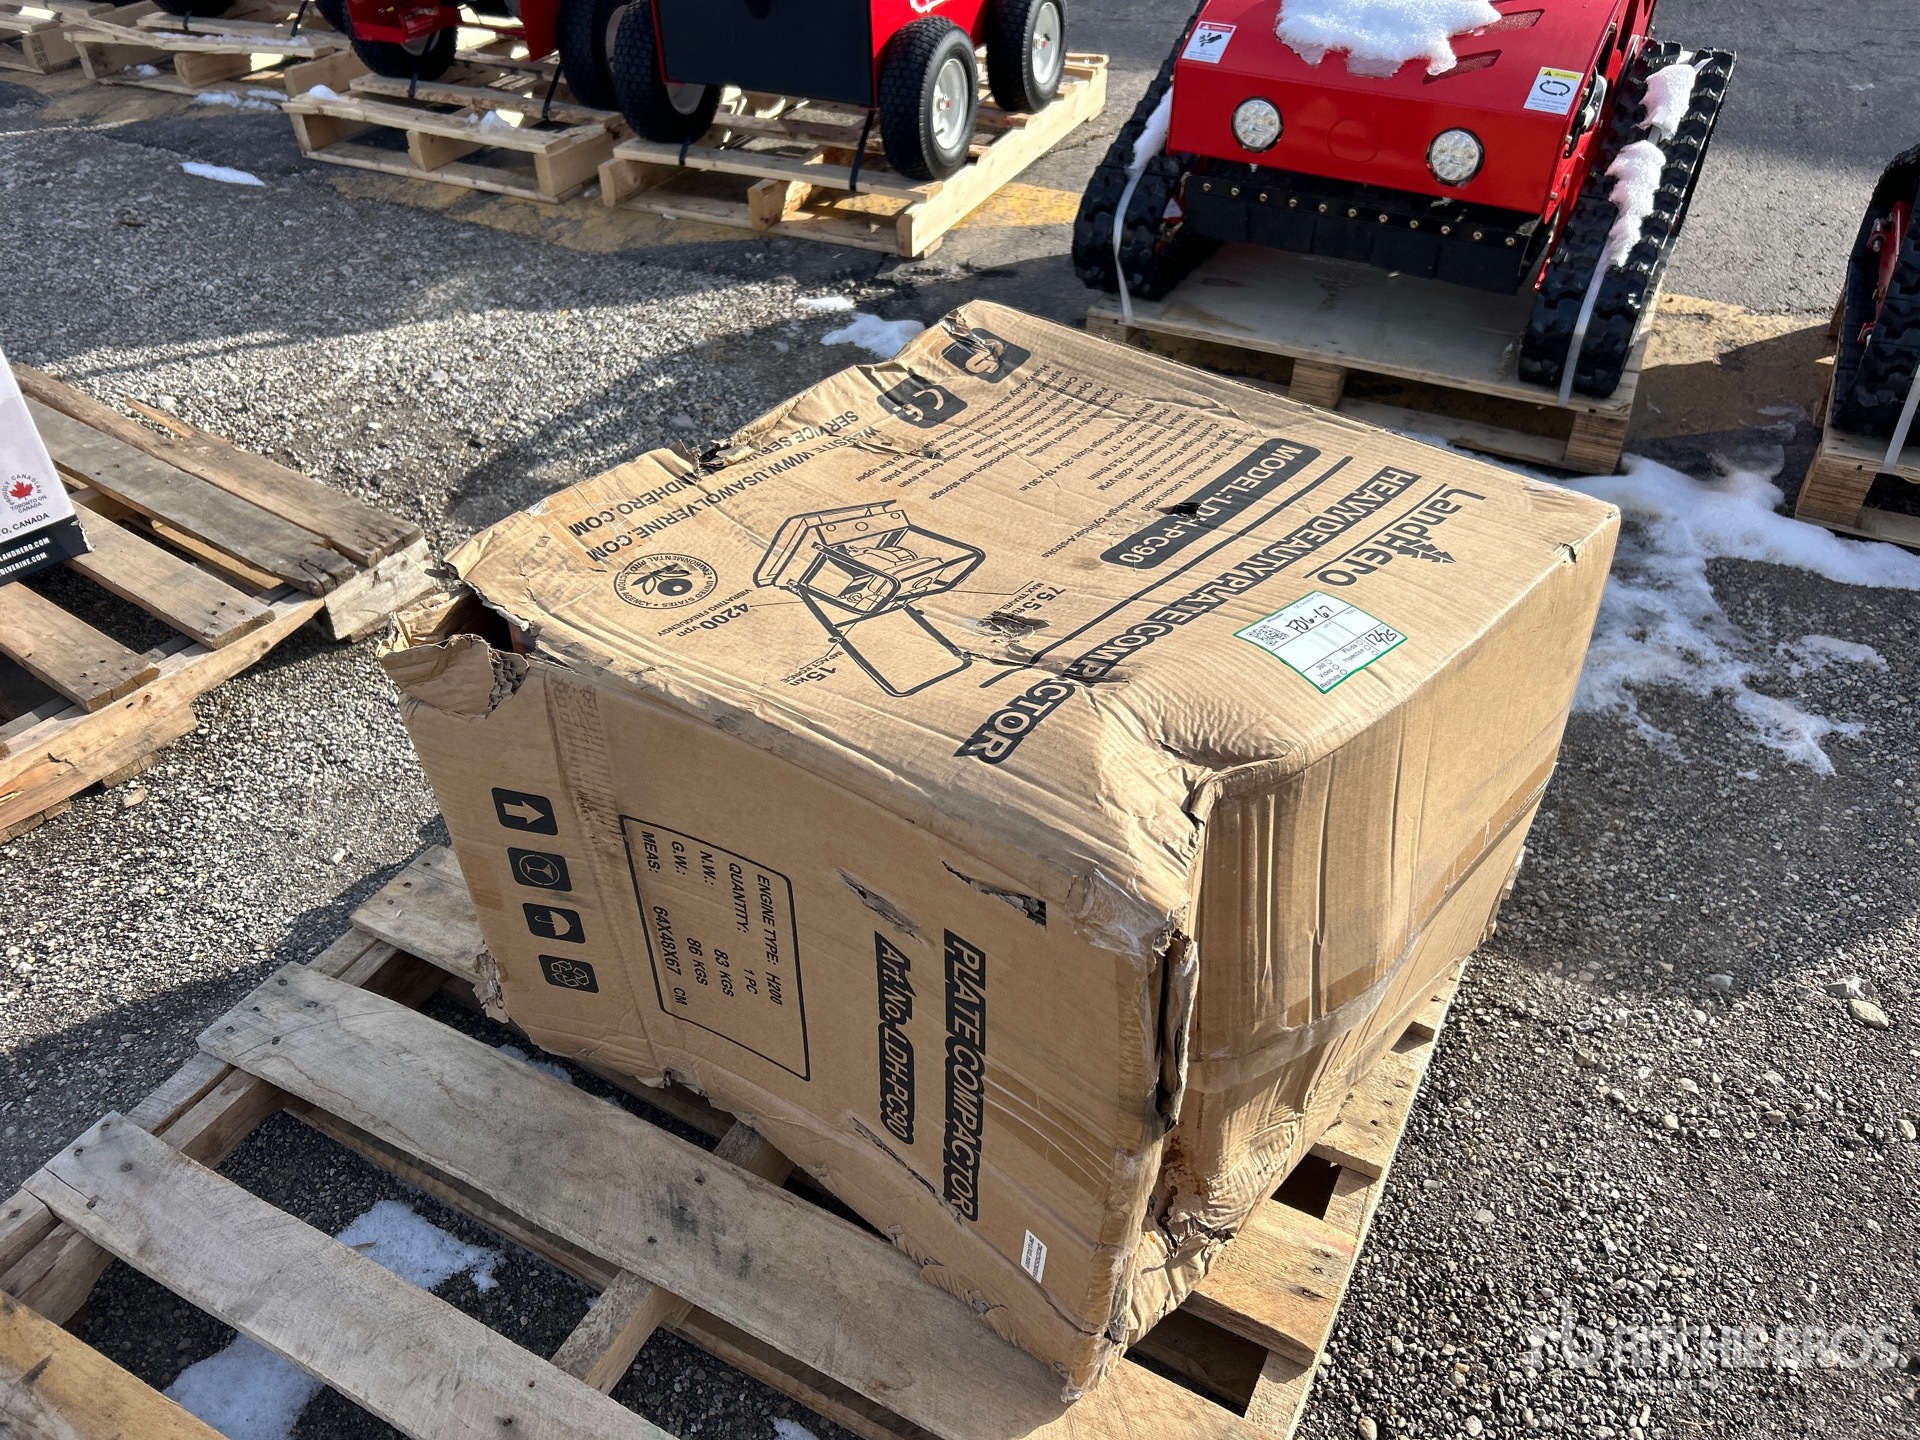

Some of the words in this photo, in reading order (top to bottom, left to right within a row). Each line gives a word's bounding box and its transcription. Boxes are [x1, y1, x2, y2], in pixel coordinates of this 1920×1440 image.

[792, 410, 859, 444] SERVICE
[1025, 436, 1039, 444] for
[1167, 418, 1203, 441] Vibrating
[1179, 422, 1219, 451] Centrifugal
[973, 442, 1028, 472] transportation
[1107, 456, 1127, 467] 75.5
[1122, 440, 1151, 457] Speed:
[1131, 441, 1173, 467] Frequency:
[1157, 450, 1183, 466] Force:
[958, 471, 975, 482] and
[1114, 467, 1134, 479] 4200
[1163, 448, 1210, 478] Combustion:
[11, 474, 42, 494] CANADIAN
[928, 481, 960, 499] storage
[1096, 478, 1118, 490] VPM
[1330, 469, 1413, 521] HEAVY
[10, 498, 38, 511] TORONTO
[18, 502, 42, 514] CANADA
[586, 450, 816, 562] WWW.USAWOLVERINE.COM
[12, 512, 50, 530] CANADA
[1242, 519, 1339, 575] DEAUTY
[0, 552, 48, 577] OLVERINE.COM
[1154, 579, 1250, 622] PLATE
[671, 840, 687, 875] G.W.:
[699, 850, 716, 885] N.W.:
[757, 874, 775, 926] ENGINE
[641, 830, 660, 872] MEAS:
[653, 906, 681, 975] 64X48X67
[672, 987, 687, 1005] CM
[728, 862, 748, 932] QUANTITY:
[744, 975, 758, 994] PC
[686, 937, 703, 956] 86
[713, 948, 729, 967] 83
[763, 928, 778, 965] TYPE:
[692, 959, 708, 985] KGS
[719, 970, 734, 997] KGS
[765, 971, 782, 1005] H200
[952, 938, 981, 1046] PLATE
[882, 983, 908, 1030] No.
[882, 1025, 909, 1141] LDH-PC90
[948, 1039, 981, 1219] COMPACTOR
